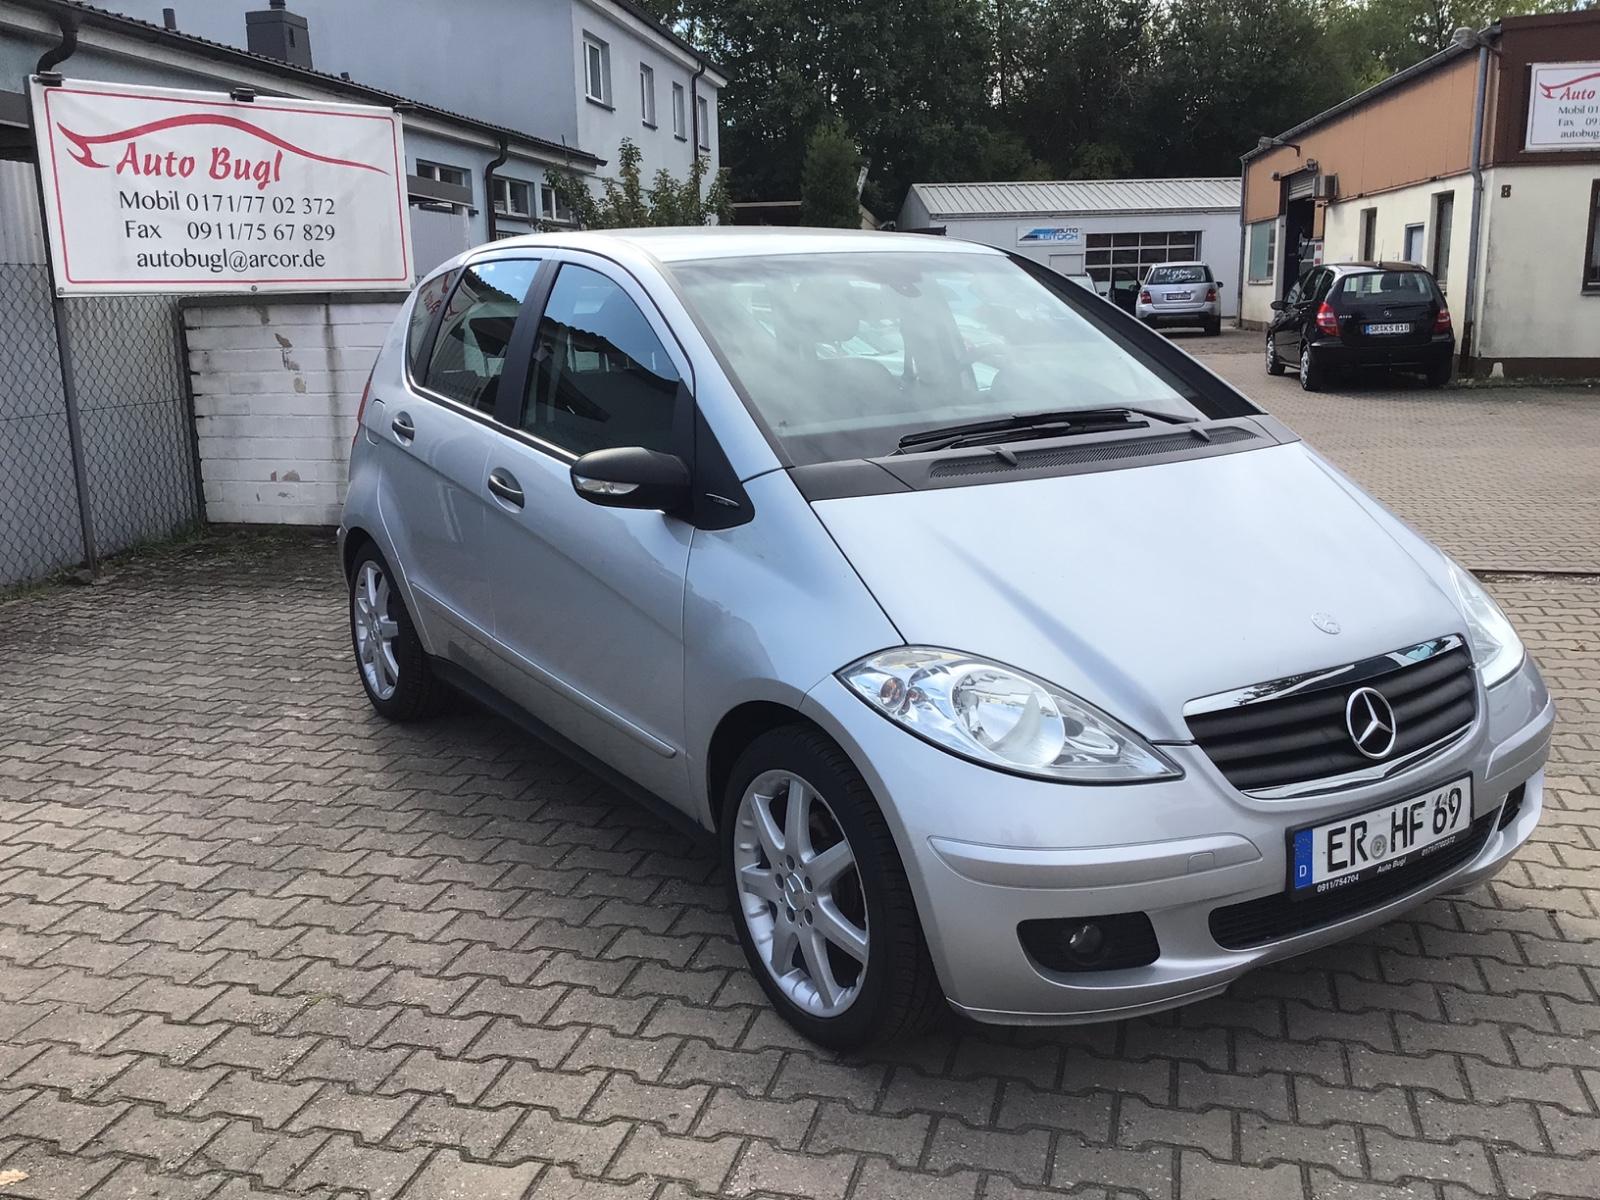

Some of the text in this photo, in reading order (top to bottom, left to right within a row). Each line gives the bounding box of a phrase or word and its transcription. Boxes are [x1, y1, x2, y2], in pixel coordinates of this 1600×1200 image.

[1560, 87, 1596, 100] Auto
[1559, 106, 1585, 114] Mobil
[1559, 118, 1574, 126] Fax
[116, 142, 283, 190] Auto Bugl
[1501, 185, 1511, 197] 8
[119, 190, 335, 215] Mobil 0171/77 02 372
[125, 220, 335, 241] Fax 0911/75 67 829
[137, 248, 326, 273] autobugl@arcor.de
[1328, 787, 1462, 873] ER HF 69
[1300, 865, 1306, 877] D
[1376, 864, 1392, 873] Auto
[1317, 873, 1359, 893] 0911/754704
